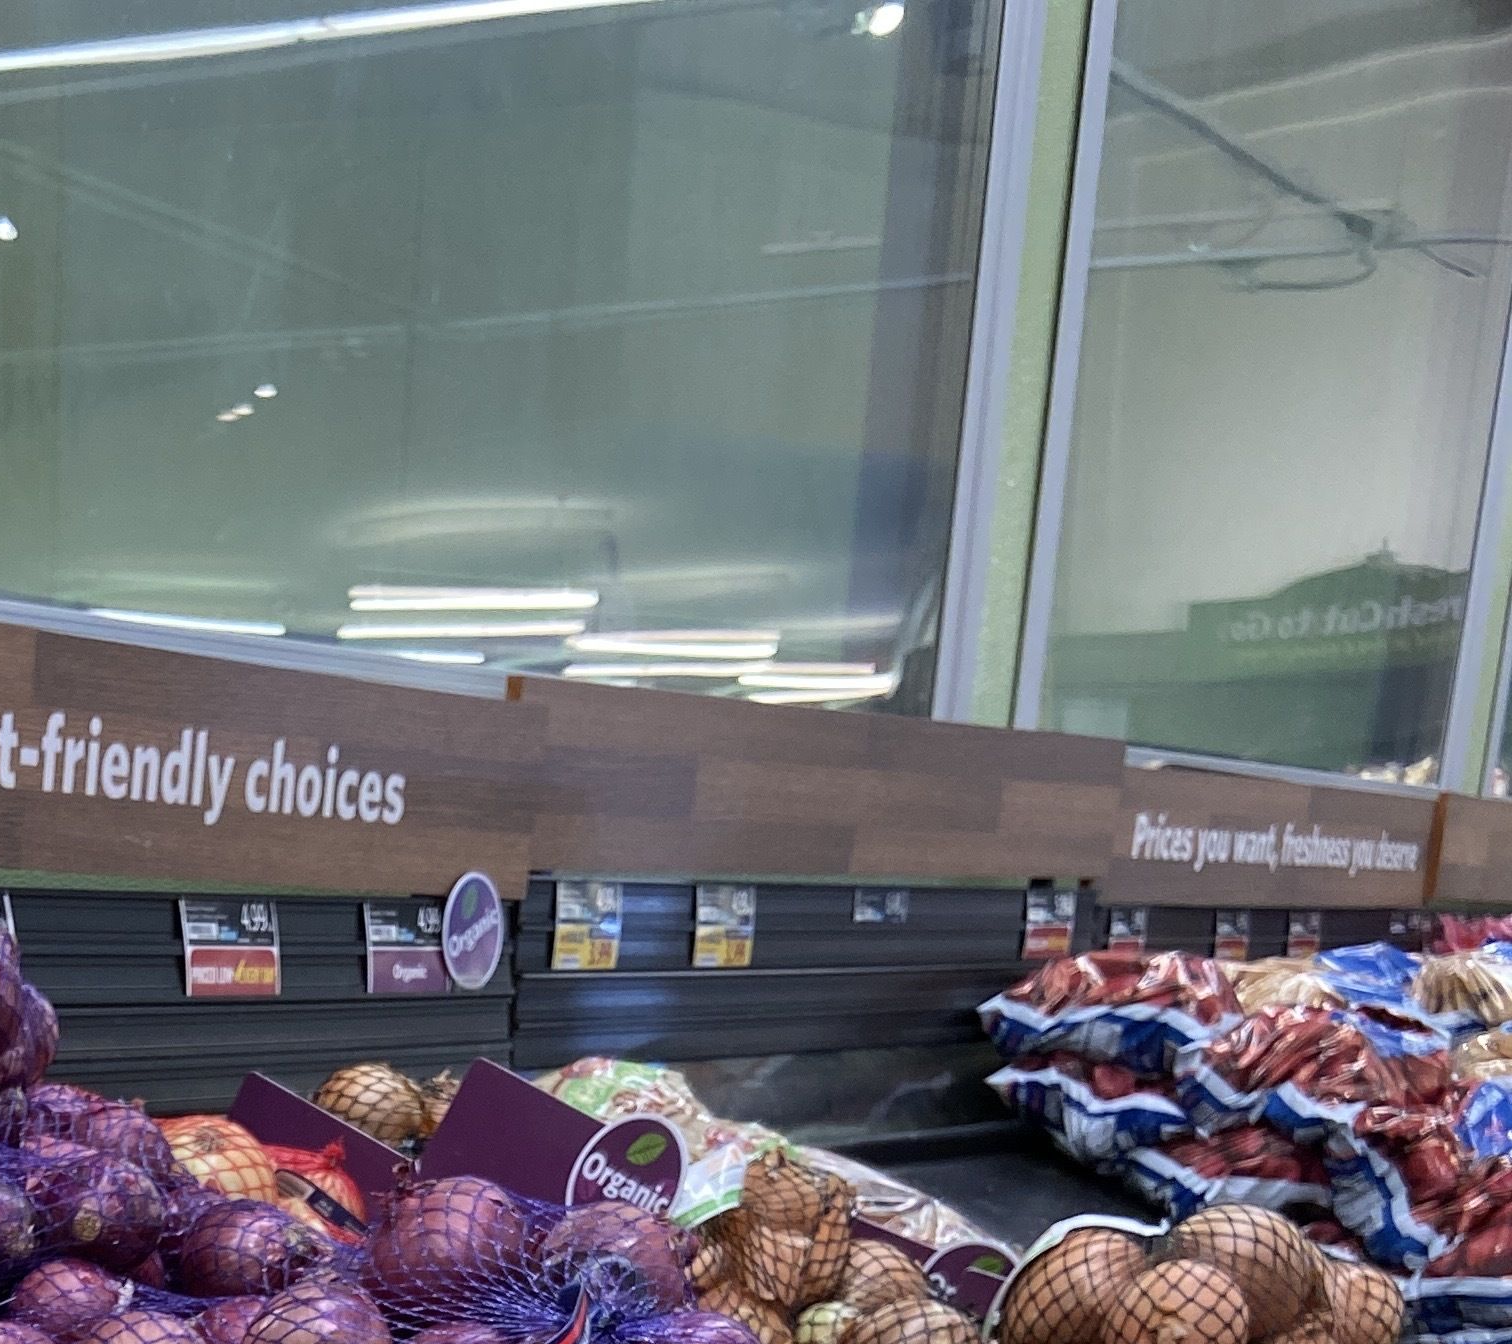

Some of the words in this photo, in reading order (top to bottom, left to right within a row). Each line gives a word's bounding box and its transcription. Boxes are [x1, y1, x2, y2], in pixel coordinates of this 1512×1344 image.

[244, 744, 407, 825] choices
[1131, 811, 1192, 861] Prices
[1192, 829, 1230, 873] you
[1233, 823, 1278, 874] want,
[1280, 821, 1351, 870] freshness
[1347, 838, 1375, 879] you
[448, 906, 499, 958] Organic
[582, 1151, 670, 1215] Organic
